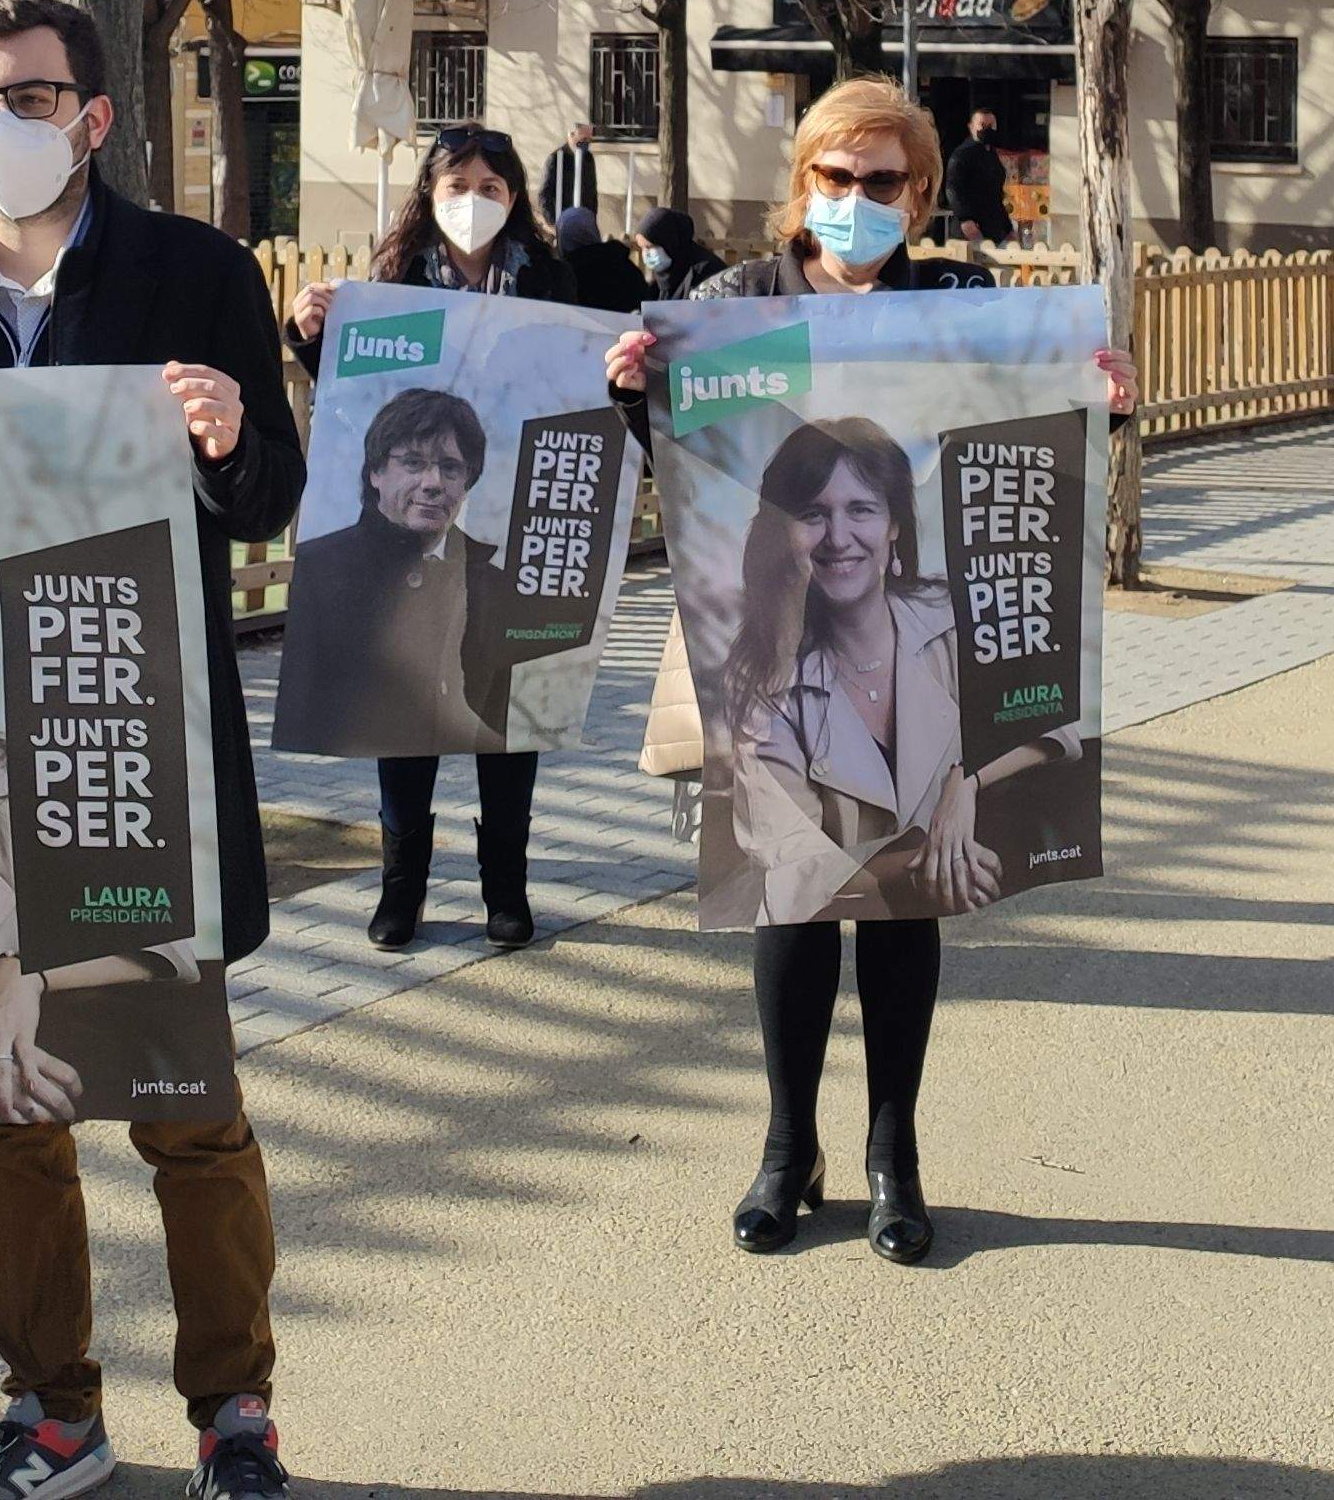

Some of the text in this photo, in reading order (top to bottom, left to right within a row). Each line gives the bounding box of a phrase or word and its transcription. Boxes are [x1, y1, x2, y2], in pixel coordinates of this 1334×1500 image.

[344, 327, 425, 362] junts
[679, 366, 788, 411] junts
[533, 429, 604, 453] JUNTS
[957, 443, 1055, 468] JUNTS
[532, 450, 599, 483] PER
[527, 479, 599, 514] FER.
[961, 467, 1055, 505] PER
[523, 516, 592, 538] JUNTS
[962, 505, 1060, 546] FER.
[520, 535, 591, 569] PER
[964, 552, 1052, 582] JUNTS
[23, 574, 139, 605] JUNTS
[516, 565, 589, 598] SER.
[968, 576, 1053, 623] PER
[28, 605, 146, 654] PER
[506, 628, 583, 640] PUIGDEMONT
[974, 616, 1061, 665] SER.
[30, 656, 156, 705] FER.
[1002, 683, 1063, 708] LAURA
[30, 717, 149, 748] JUNTS
[35, 750, 154, 798] PER
[36, 800, 166, 849] SER.
[1028, 844, 1083, 869] junts.cat
[84, 886, 172, 908] LAURA
[70, 908, 173, 924] PRESIDENTA
[131, 1078, 207, 1098] junts.cat
